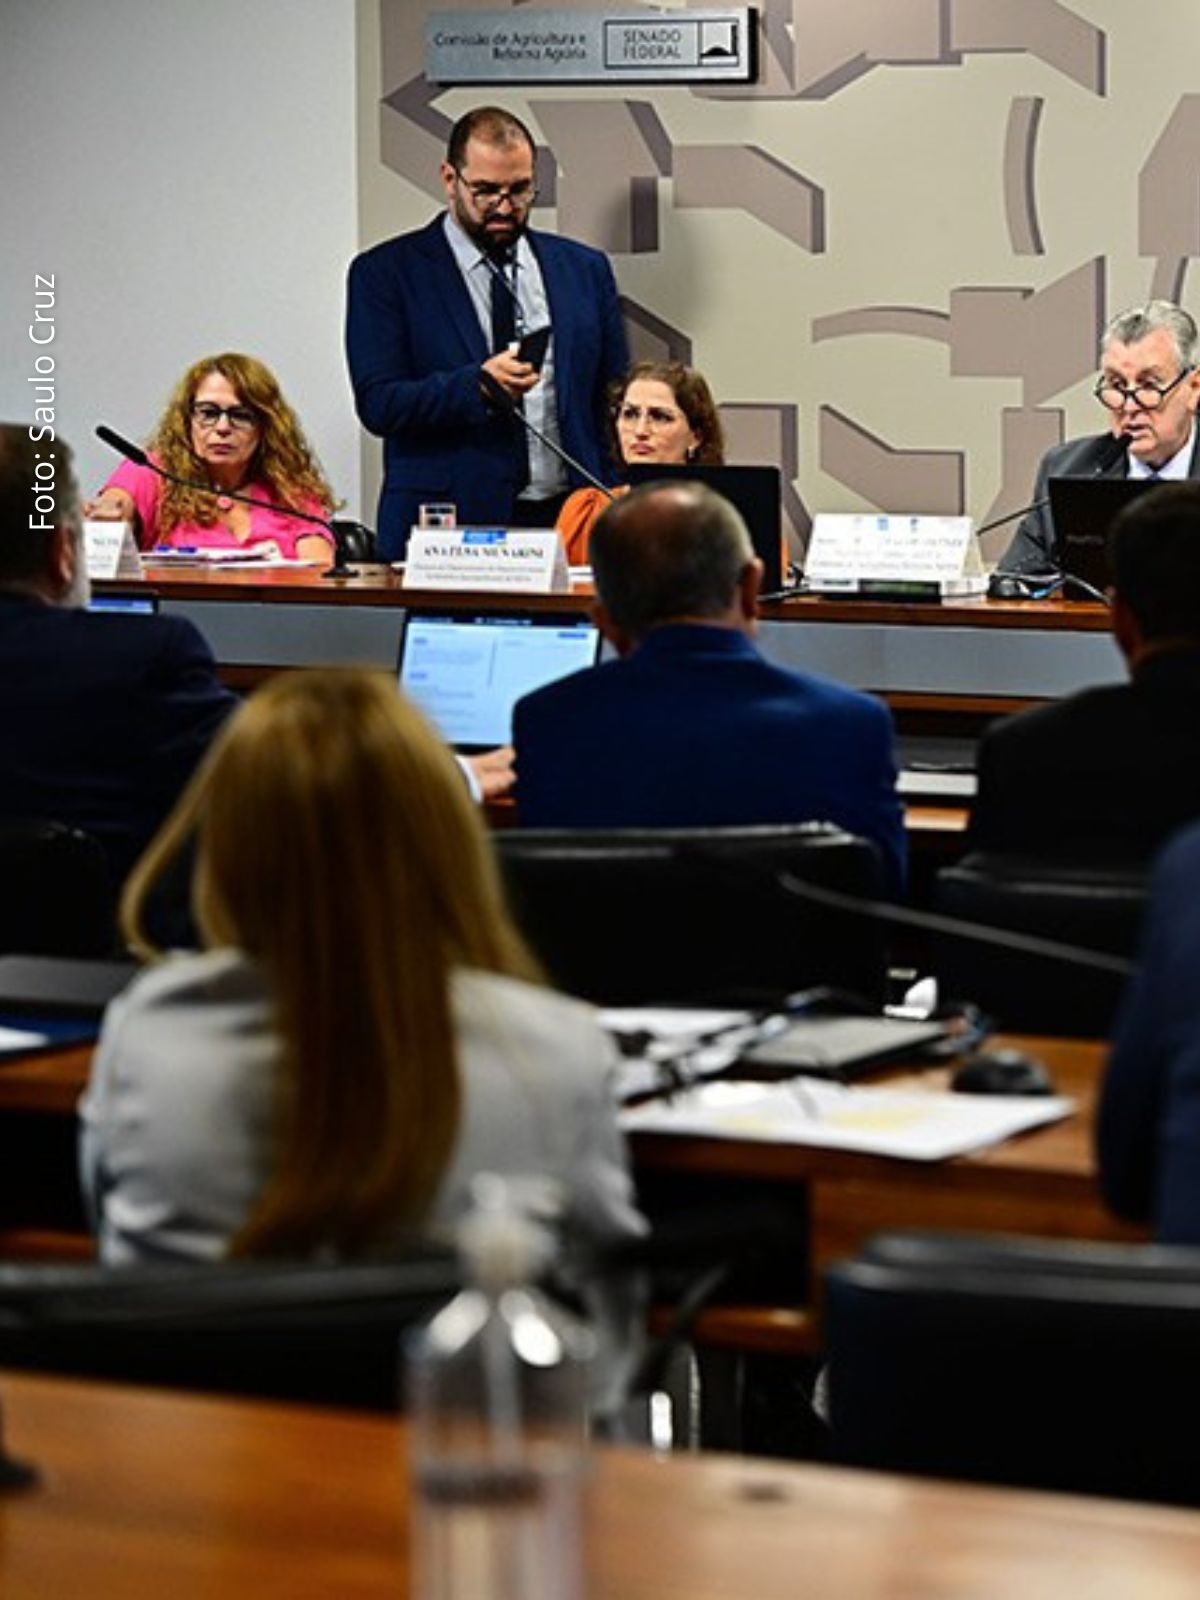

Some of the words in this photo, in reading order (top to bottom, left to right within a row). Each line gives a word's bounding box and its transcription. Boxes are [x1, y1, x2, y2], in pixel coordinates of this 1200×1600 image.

[492, 32, 510, 46] de
[513, 31, 575, 49] Agricultura
[623, 30, 682, 43] SENADO
[623, 45, 682, 59] FEDERAL
